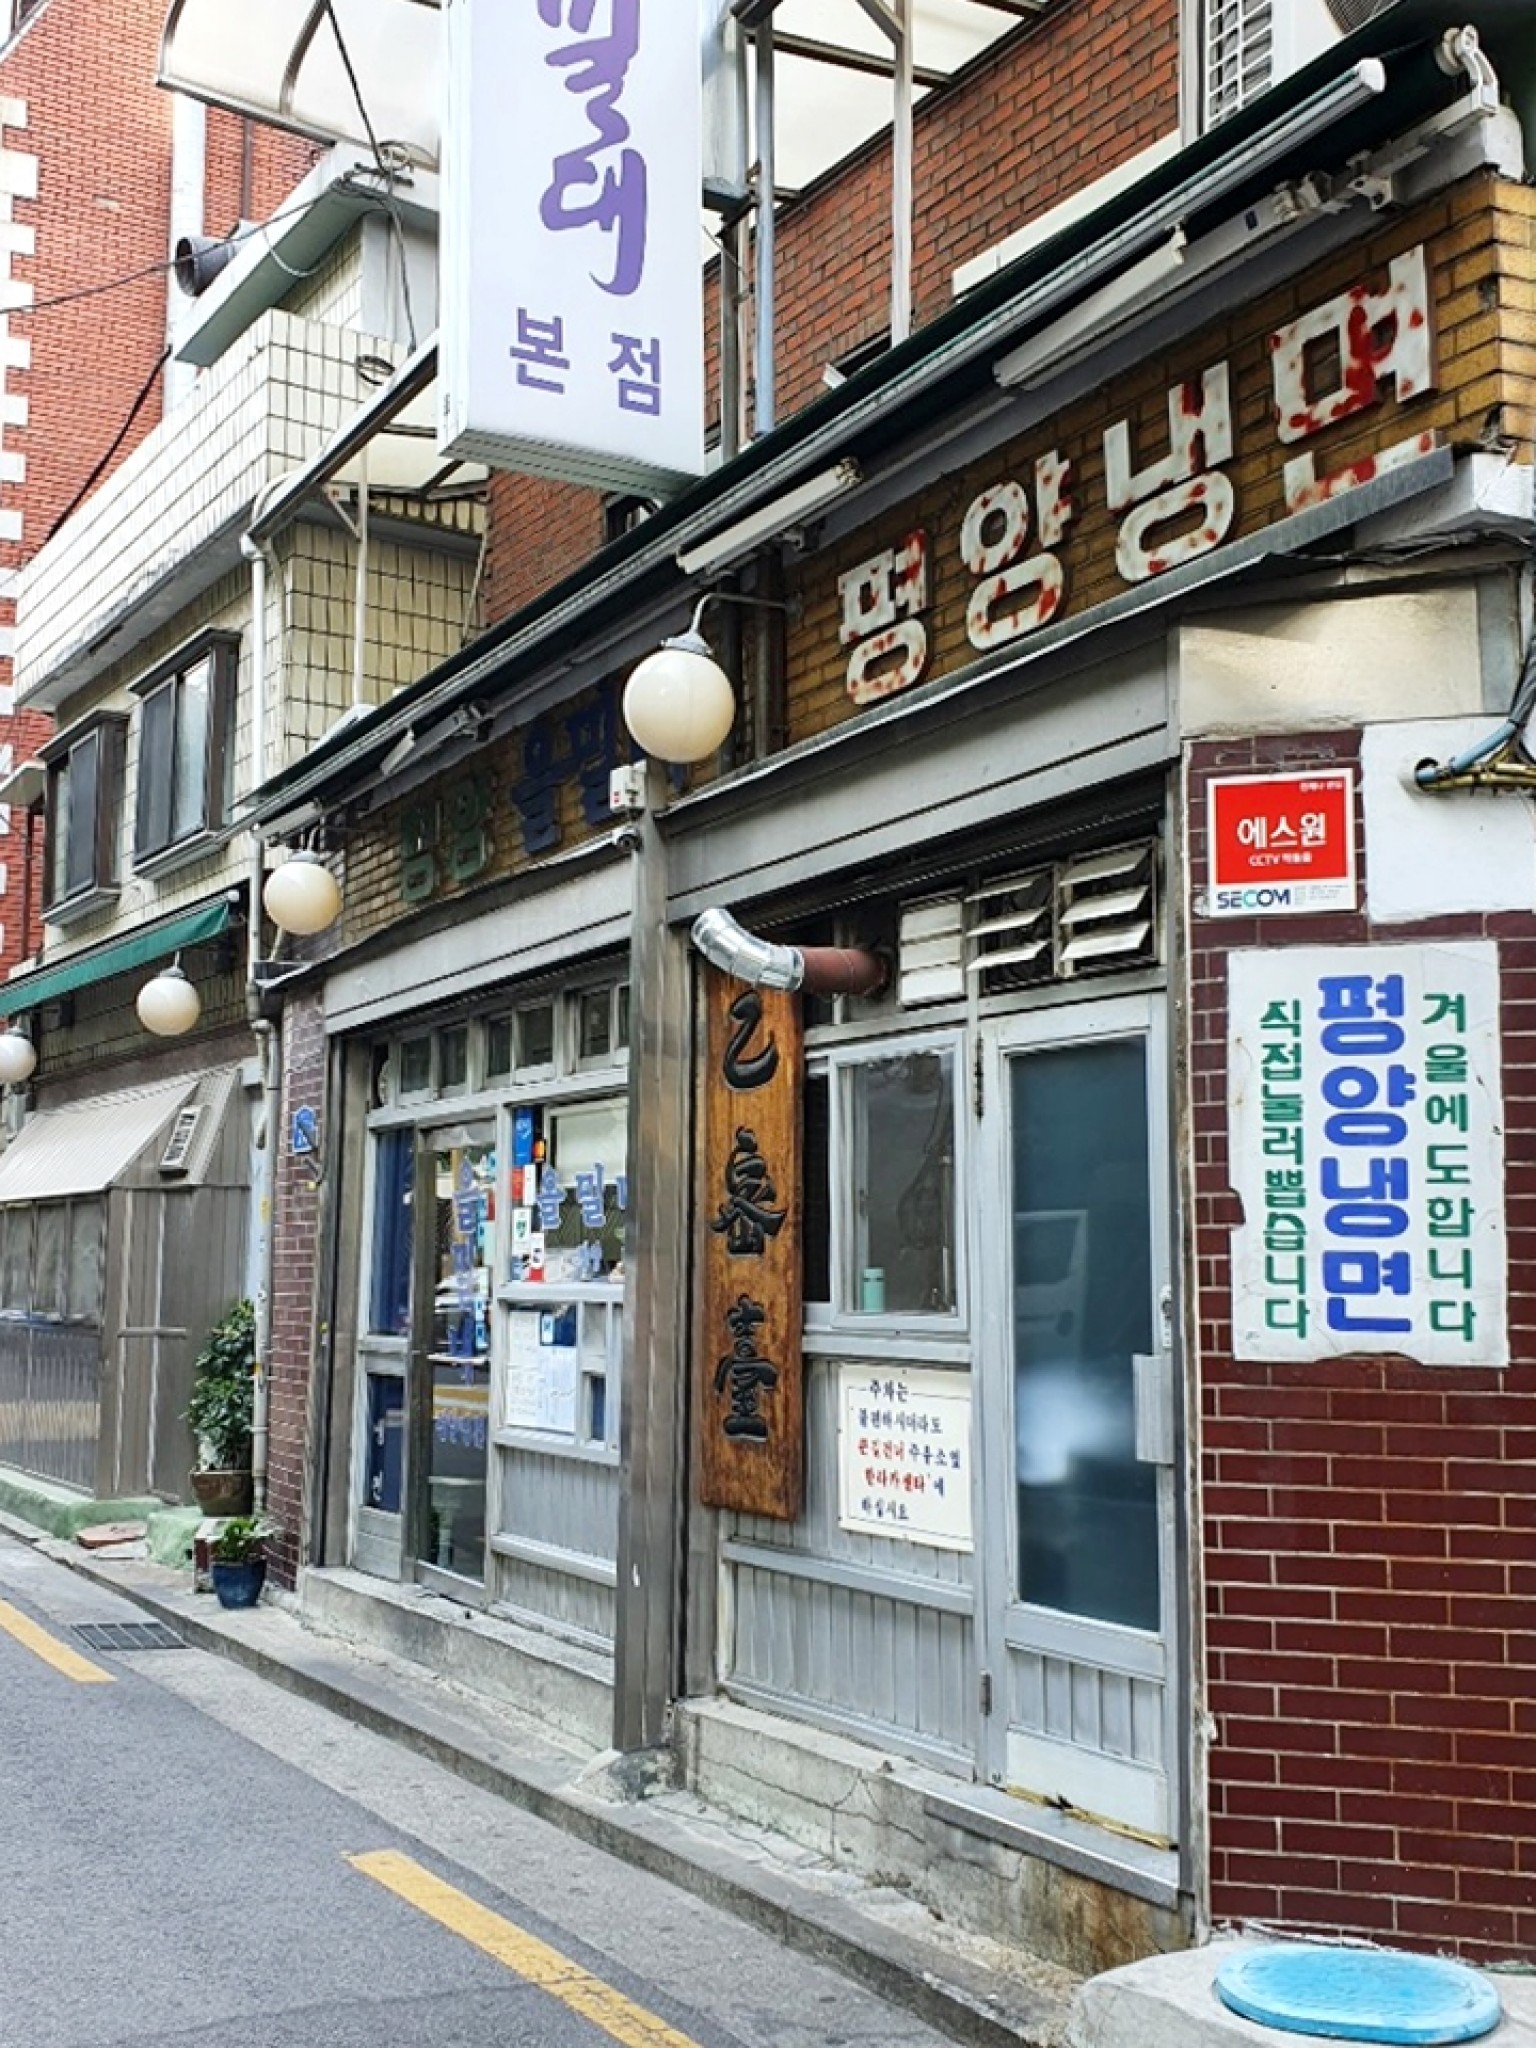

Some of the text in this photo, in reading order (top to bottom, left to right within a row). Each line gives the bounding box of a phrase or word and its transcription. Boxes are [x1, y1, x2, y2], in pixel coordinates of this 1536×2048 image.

[509, 307, 661, 416] 본점
[838, 245, 1441, 706] 평양냉면
[1217, 888, 1291, 910] SECOM
[1237, 812, 1327, 849] 에스원
[1317, 974, 1417, 1333] 평양냉면
[1421, 993, 1477, 1342] 겨울에도합니다
